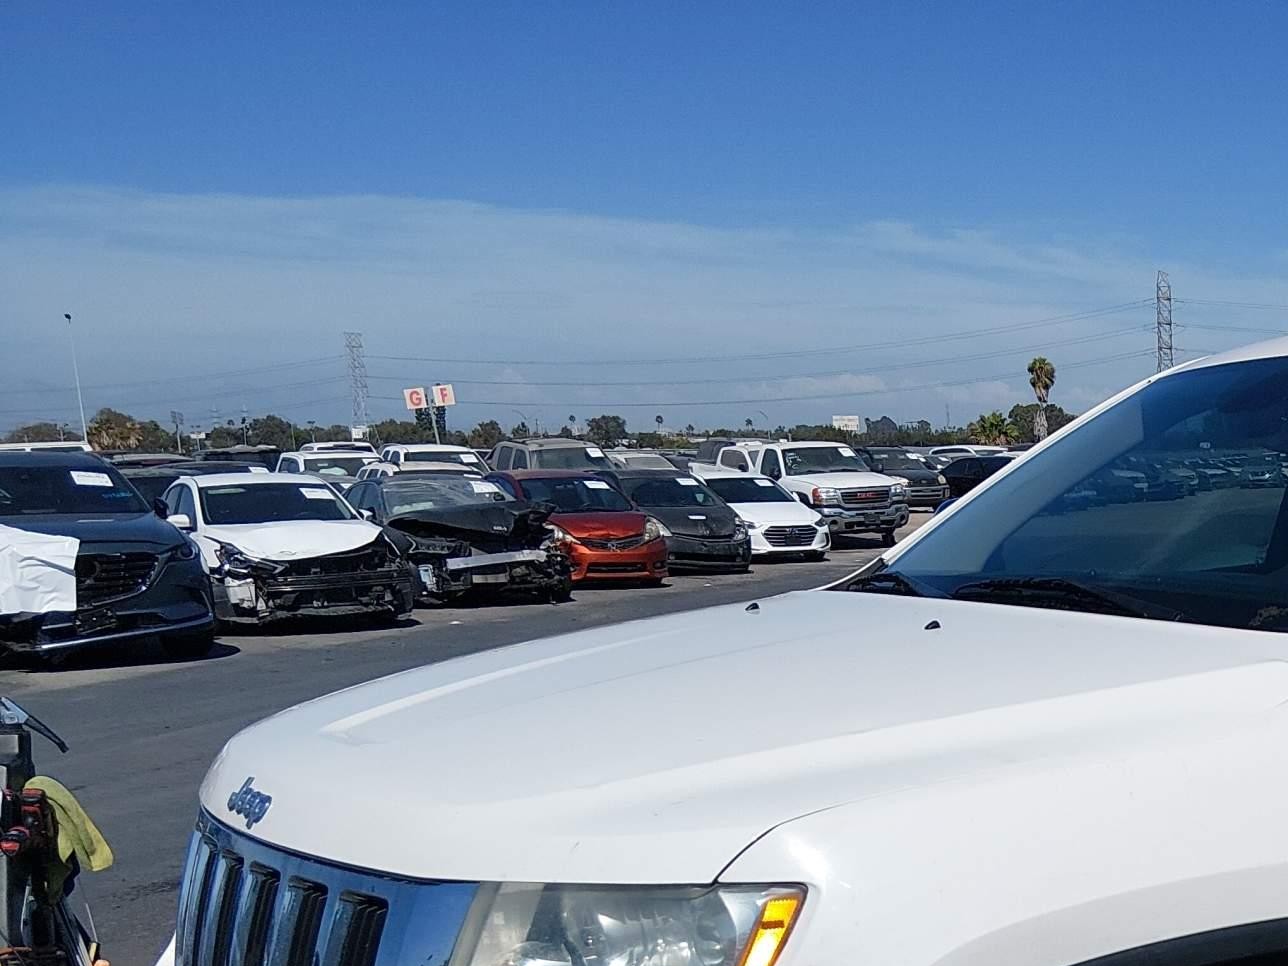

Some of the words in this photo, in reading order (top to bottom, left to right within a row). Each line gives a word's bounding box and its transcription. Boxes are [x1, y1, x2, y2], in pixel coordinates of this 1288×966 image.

[409, 390, 422, 406] G
[439, 387, 448, 404] F
[227, 776, 272, 830] Jeep
